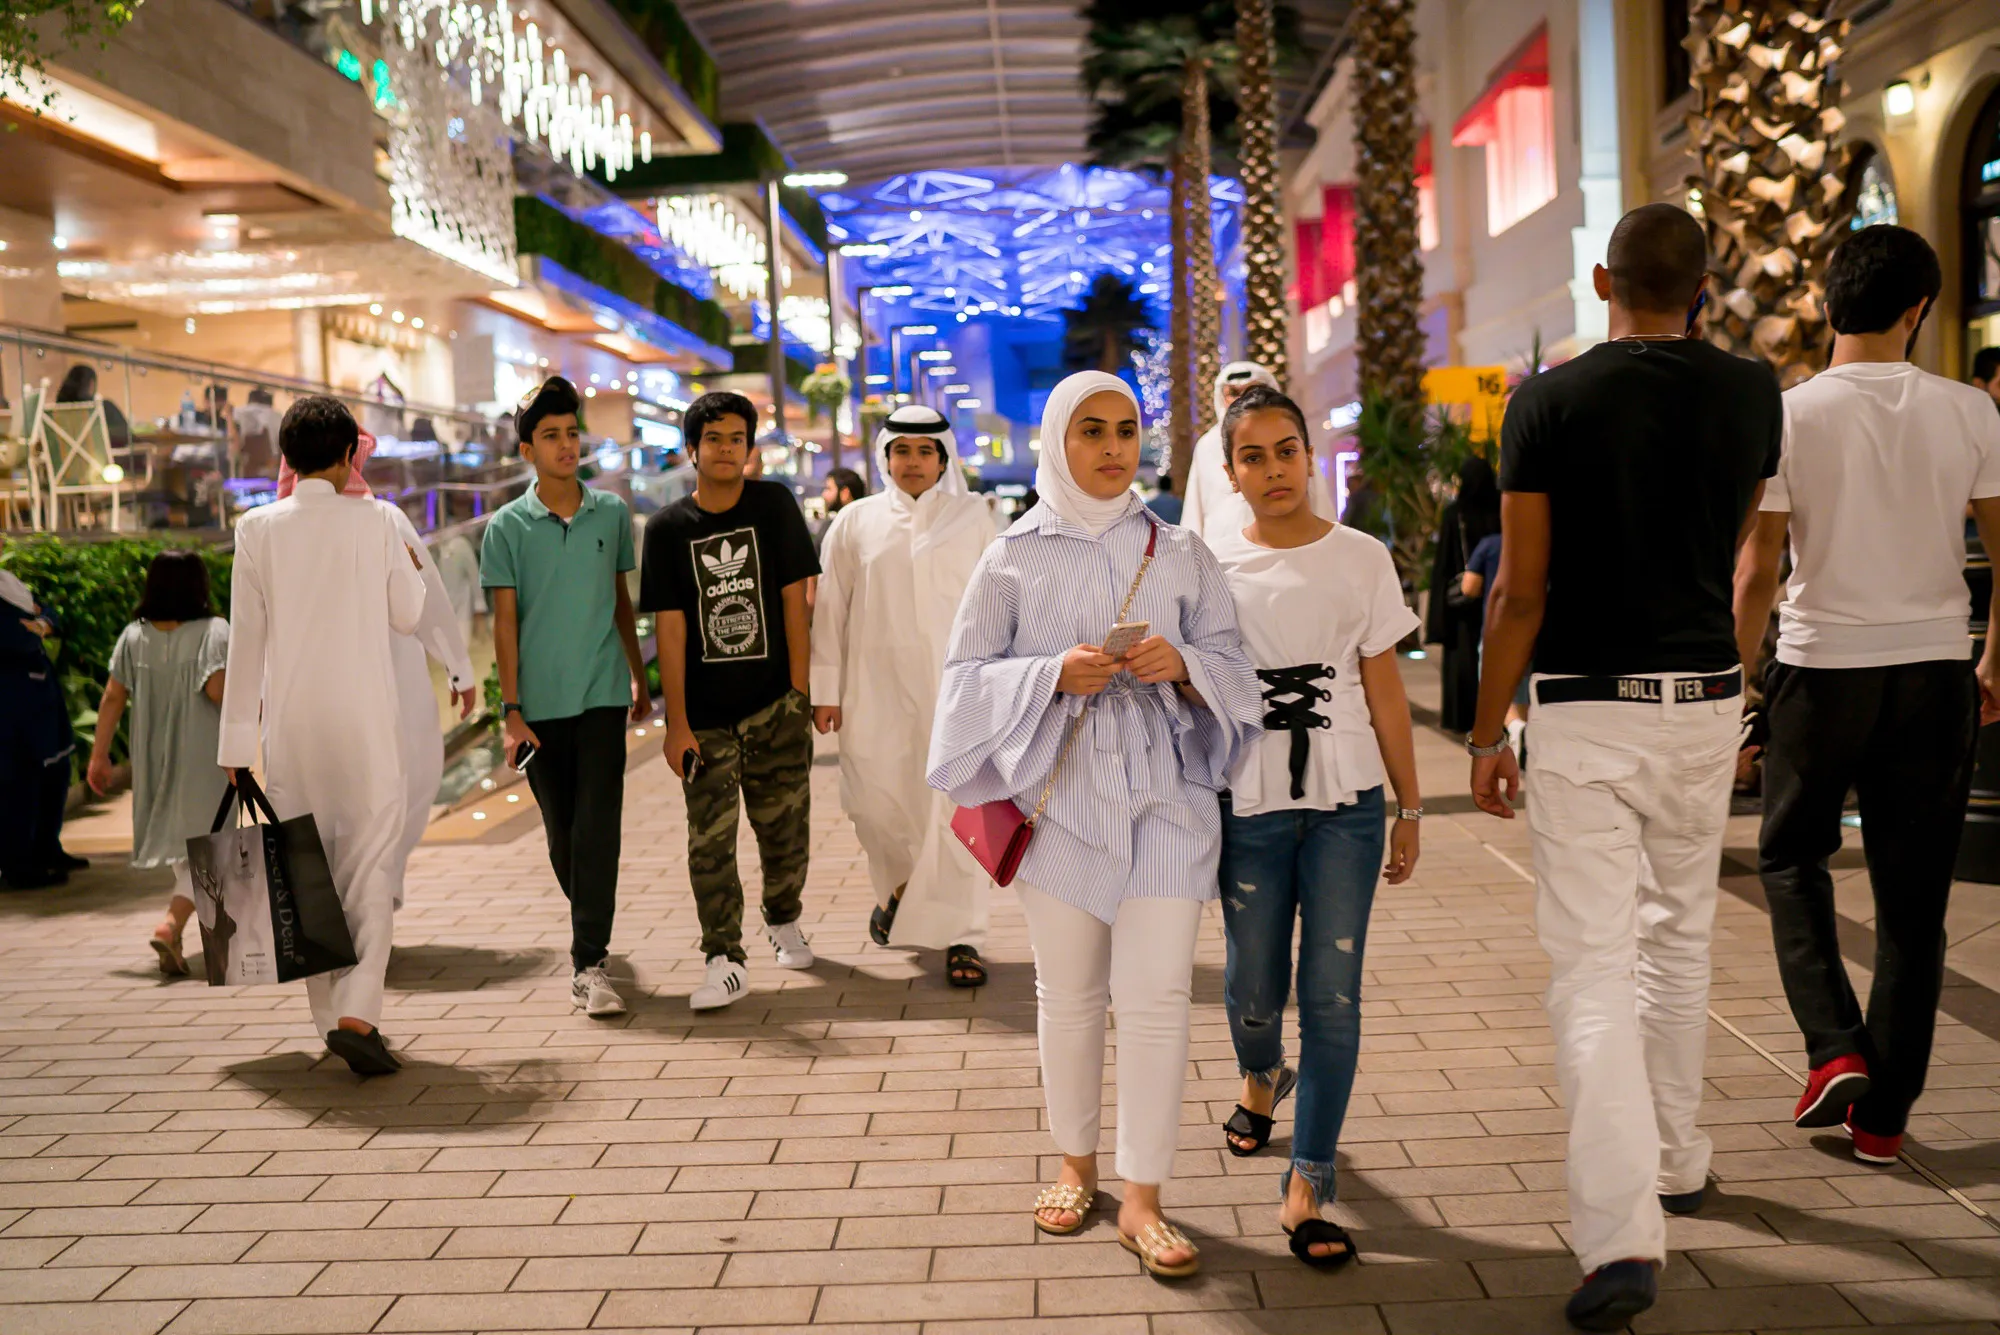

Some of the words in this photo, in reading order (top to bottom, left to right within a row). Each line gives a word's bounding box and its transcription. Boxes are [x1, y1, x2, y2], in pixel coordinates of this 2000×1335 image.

[707, 577, 755, 598] adidas
[1618, 679, 1704, 700] HOLLTER
[267, 837, 284, 887] Deer
[277, 889, 290, 903] &
